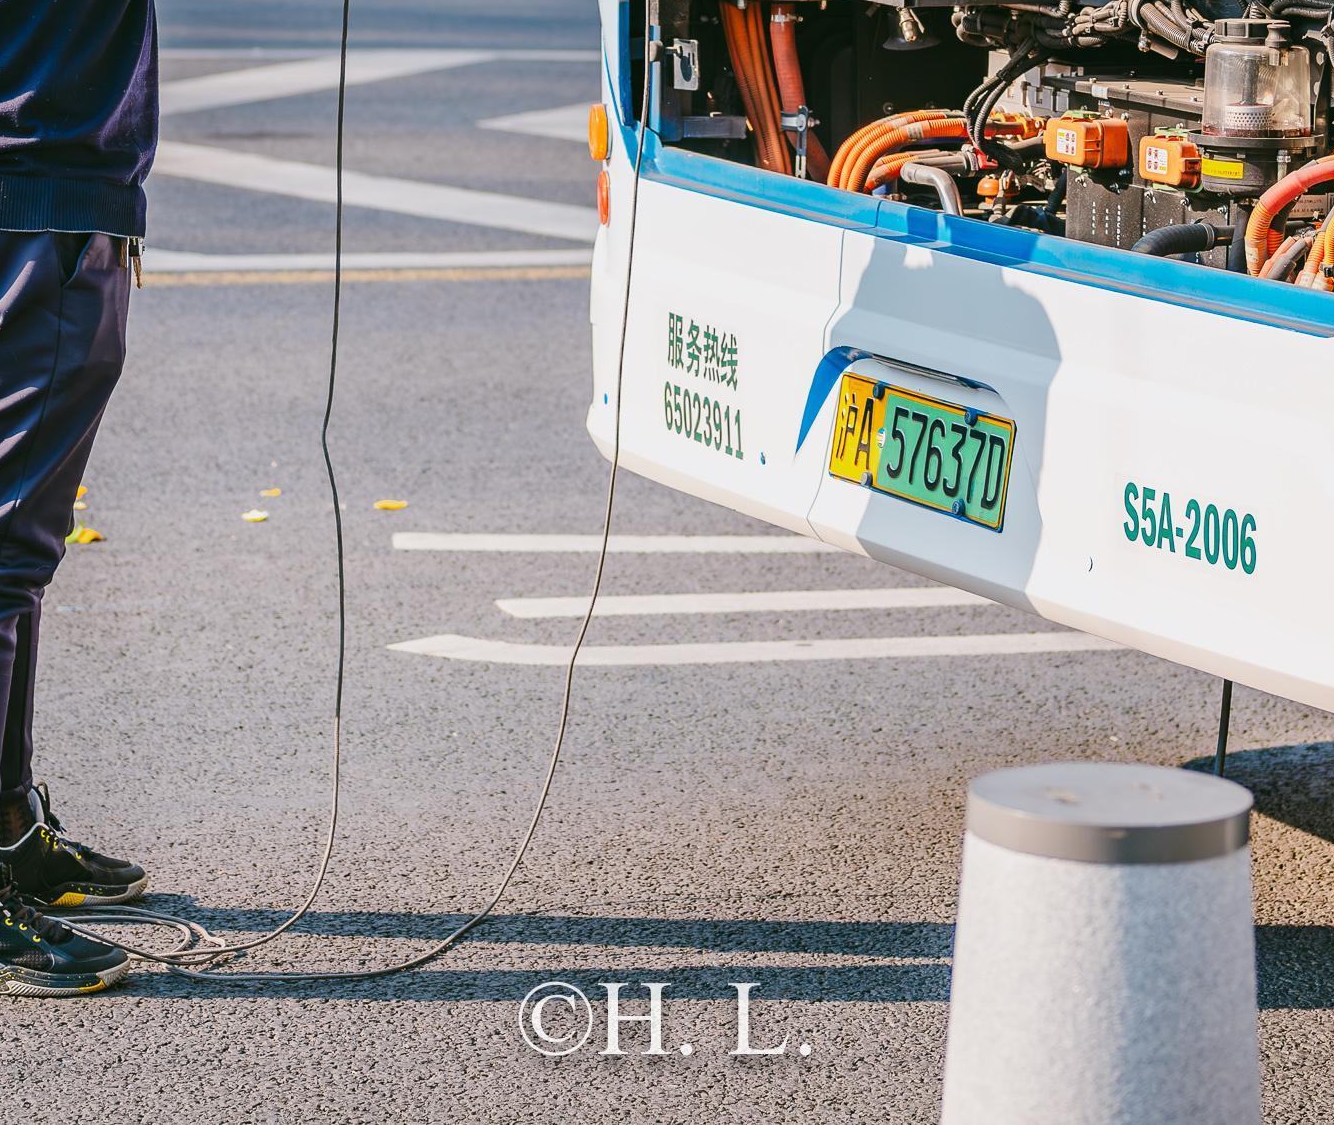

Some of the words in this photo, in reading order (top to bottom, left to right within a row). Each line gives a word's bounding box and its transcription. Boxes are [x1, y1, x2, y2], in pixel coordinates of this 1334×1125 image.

[667, 312, 738, 391] 服务热线
[664, 381, 744, 460] 65023911
[886, 406, 1005, 510] 57637D
[1123, 481, 1257, 575] S5A-2006
